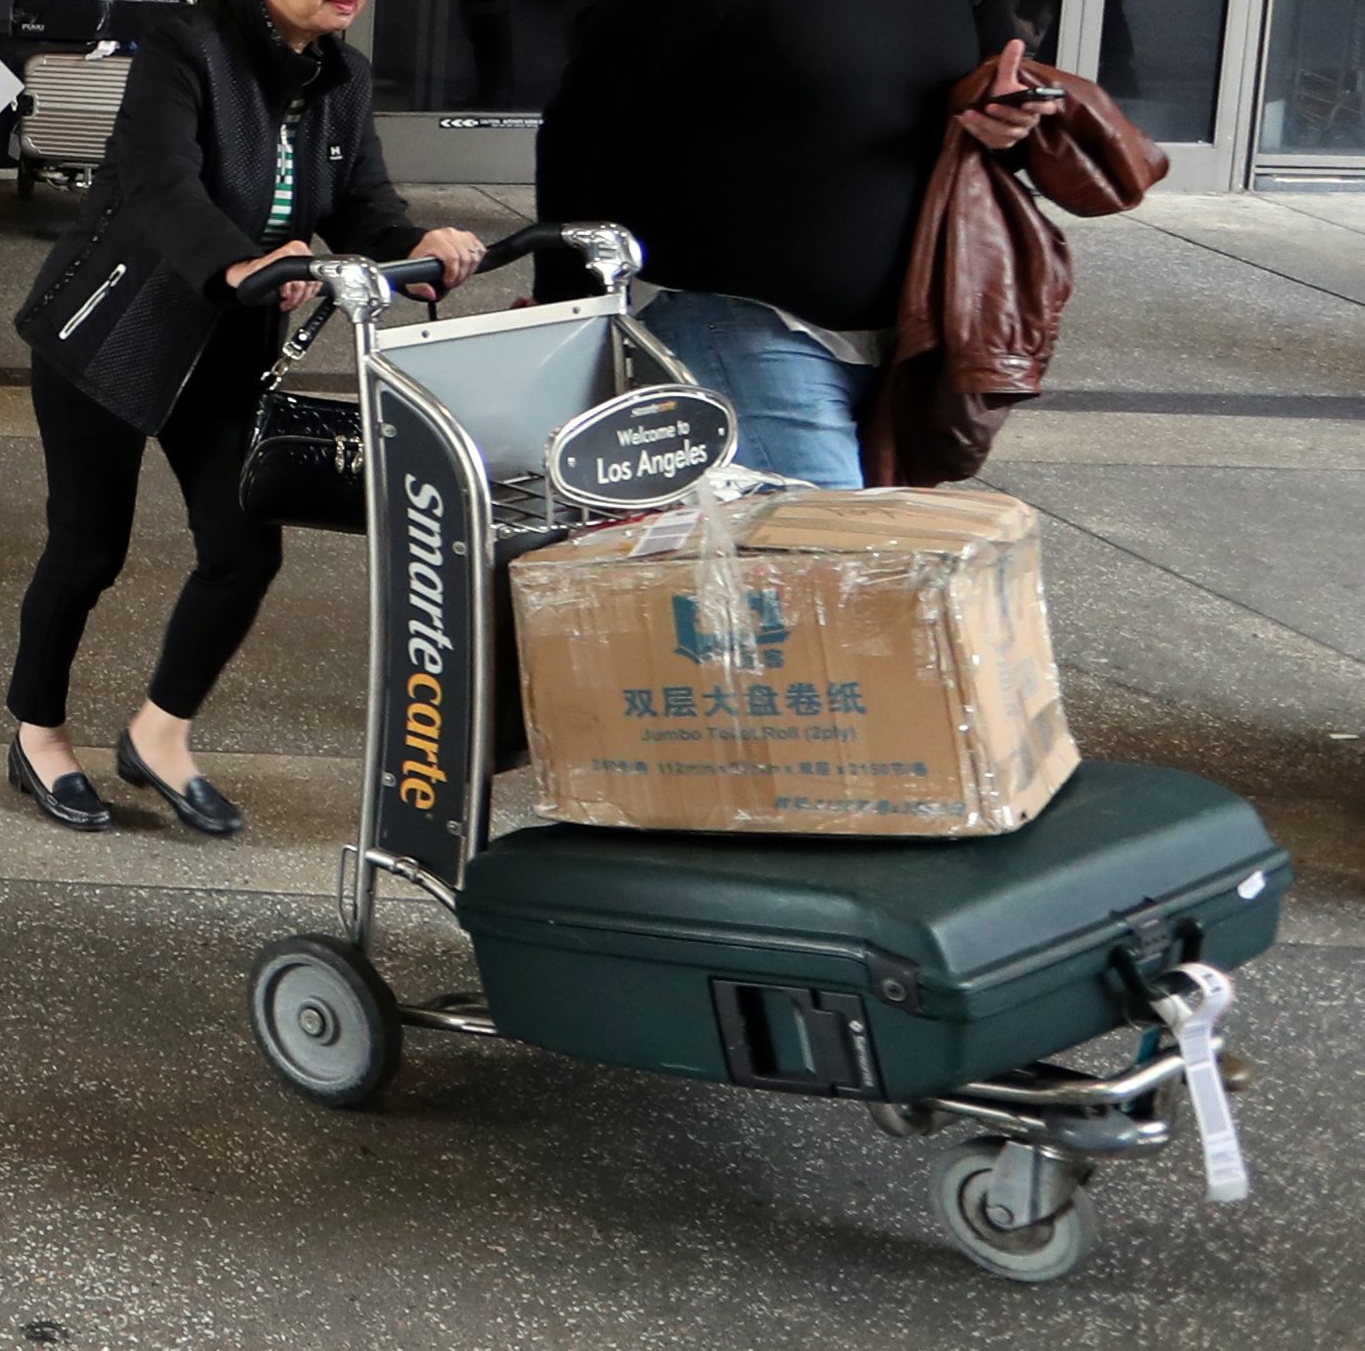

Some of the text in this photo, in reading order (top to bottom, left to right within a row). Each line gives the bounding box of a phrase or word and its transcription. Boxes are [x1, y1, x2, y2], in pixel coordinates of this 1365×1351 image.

[616, 420, 691, 447] Welcome to
[596, 439, 709, 485] Los Angeles
[621, 680, 869, 719] 双层大盘卷纸
[640, 726, 703, 743] Jumbo
[761, 725, 800, 741] Roll
[803, 725, 858, 744] (2ply)
